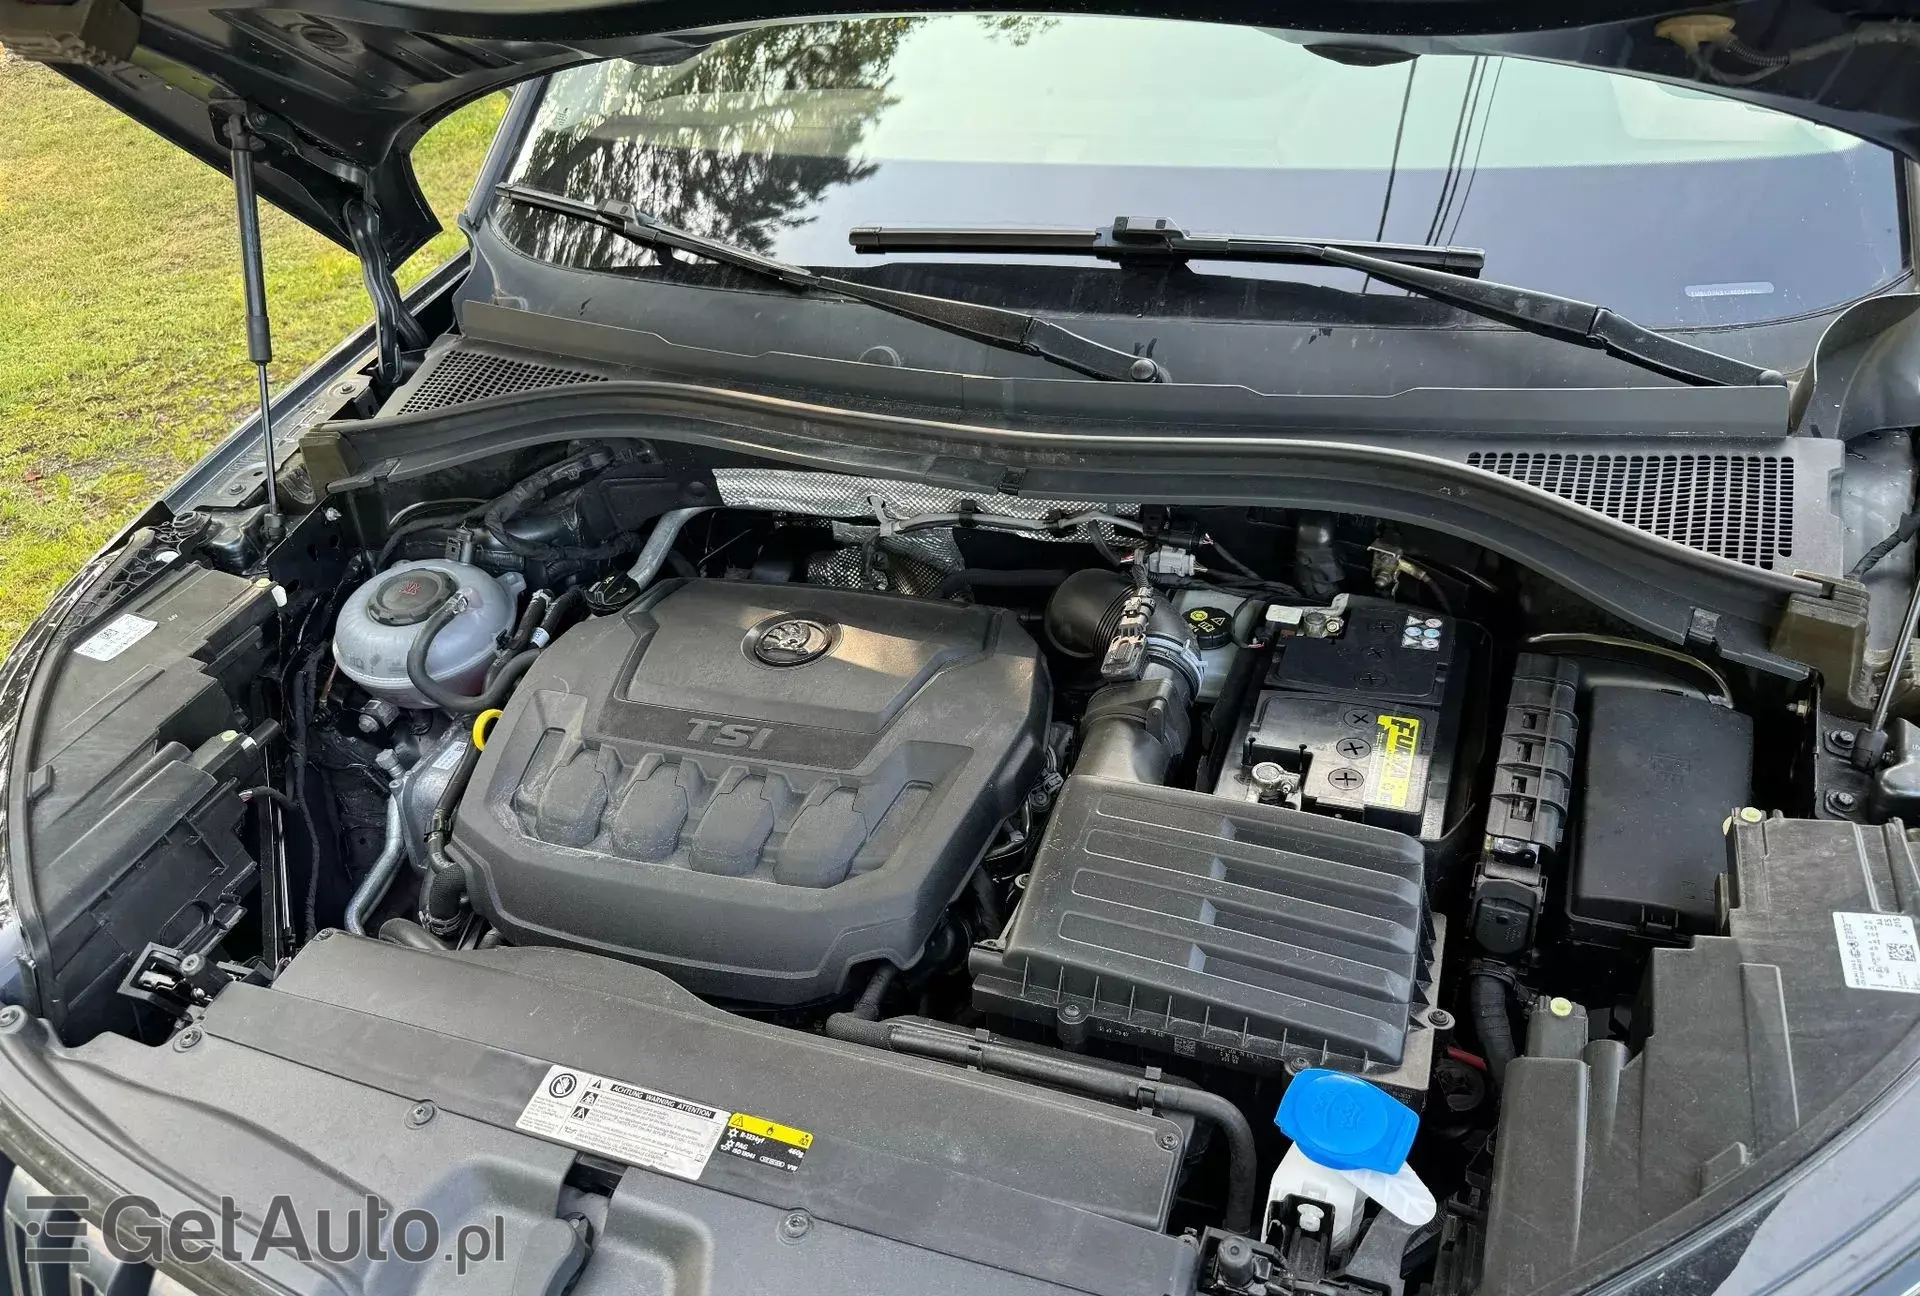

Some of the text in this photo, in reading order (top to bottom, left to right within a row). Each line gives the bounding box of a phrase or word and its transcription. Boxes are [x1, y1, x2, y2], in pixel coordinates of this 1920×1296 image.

[687, 717, 774, 751] TSI
[613, 1084, 712, 1118] ACHTUNG WARNING ATTENTION
